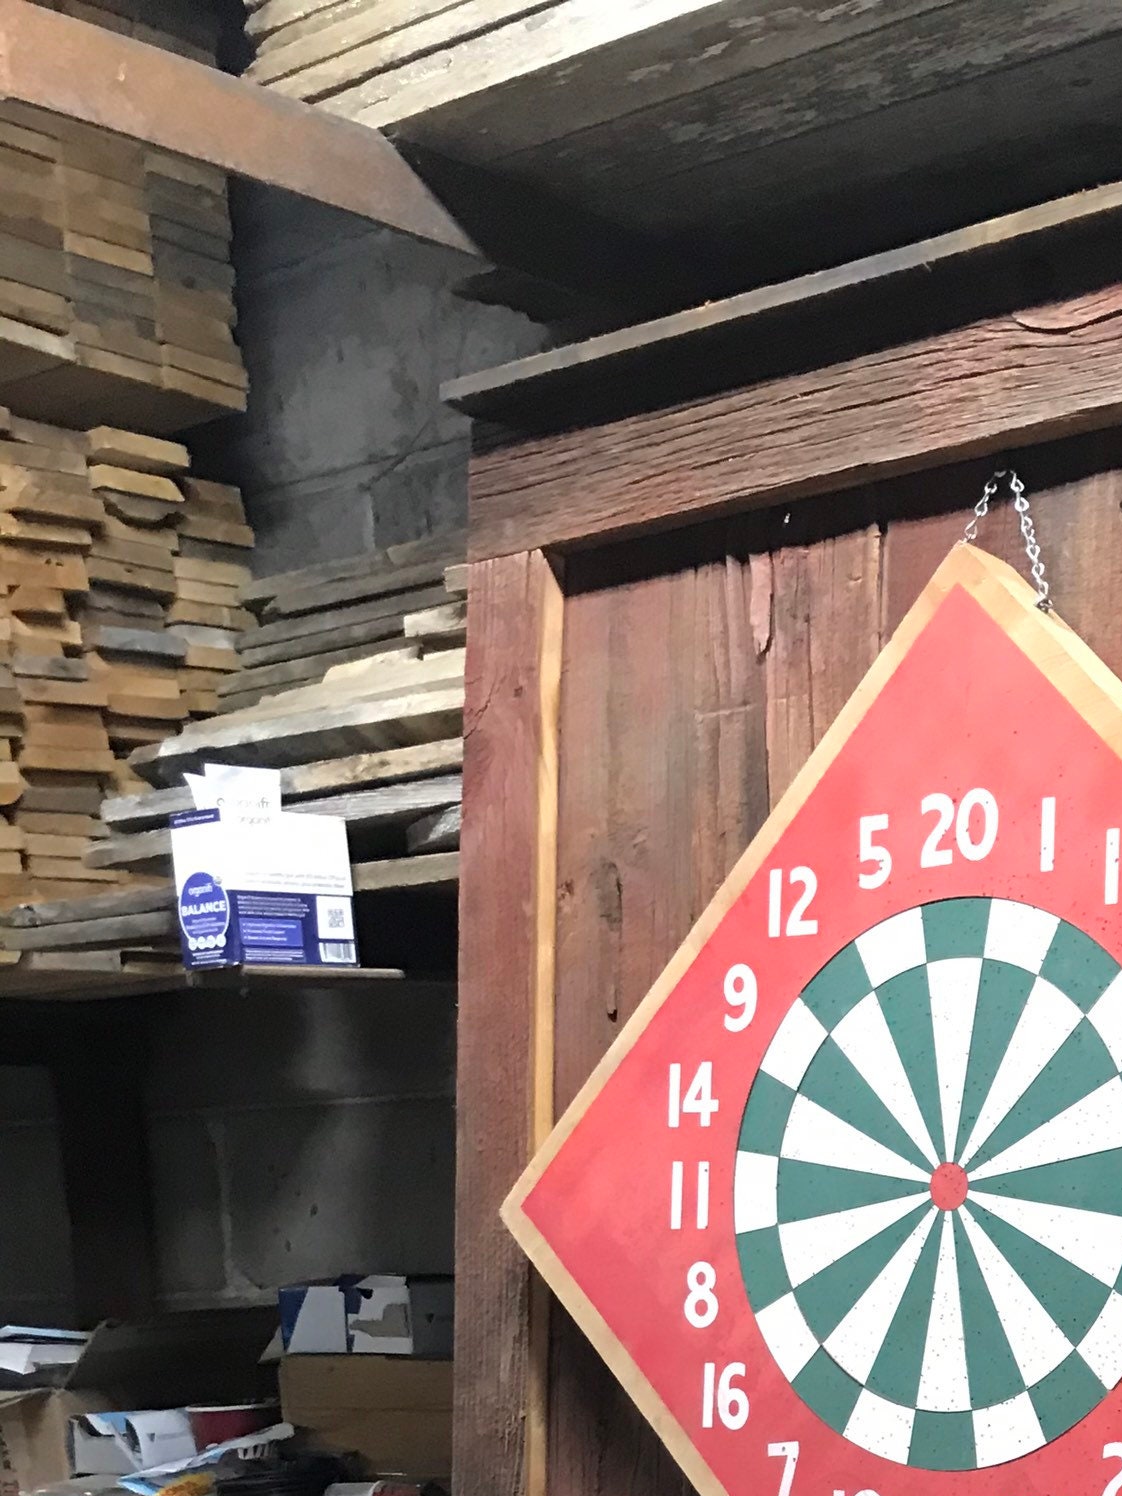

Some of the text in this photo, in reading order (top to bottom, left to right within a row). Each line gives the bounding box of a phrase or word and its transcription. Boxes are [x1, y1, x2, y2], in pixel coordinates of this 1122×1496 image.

[857, 812, 893, 890] 5
[919, 786, 1000, 869] 20
[1039, 795, 1057, 873] 1
[181, 900, 227, 917] BALANCE
[767, 865, 819, 938] 12
[723, 962, 759, 1032] 9
[667, 1060, 720, 1128] 14
[669, 1160, 711, 1230] 11
[683, 1260, 719, 1329] 8
[701, 1361, 750, 1431] 16
